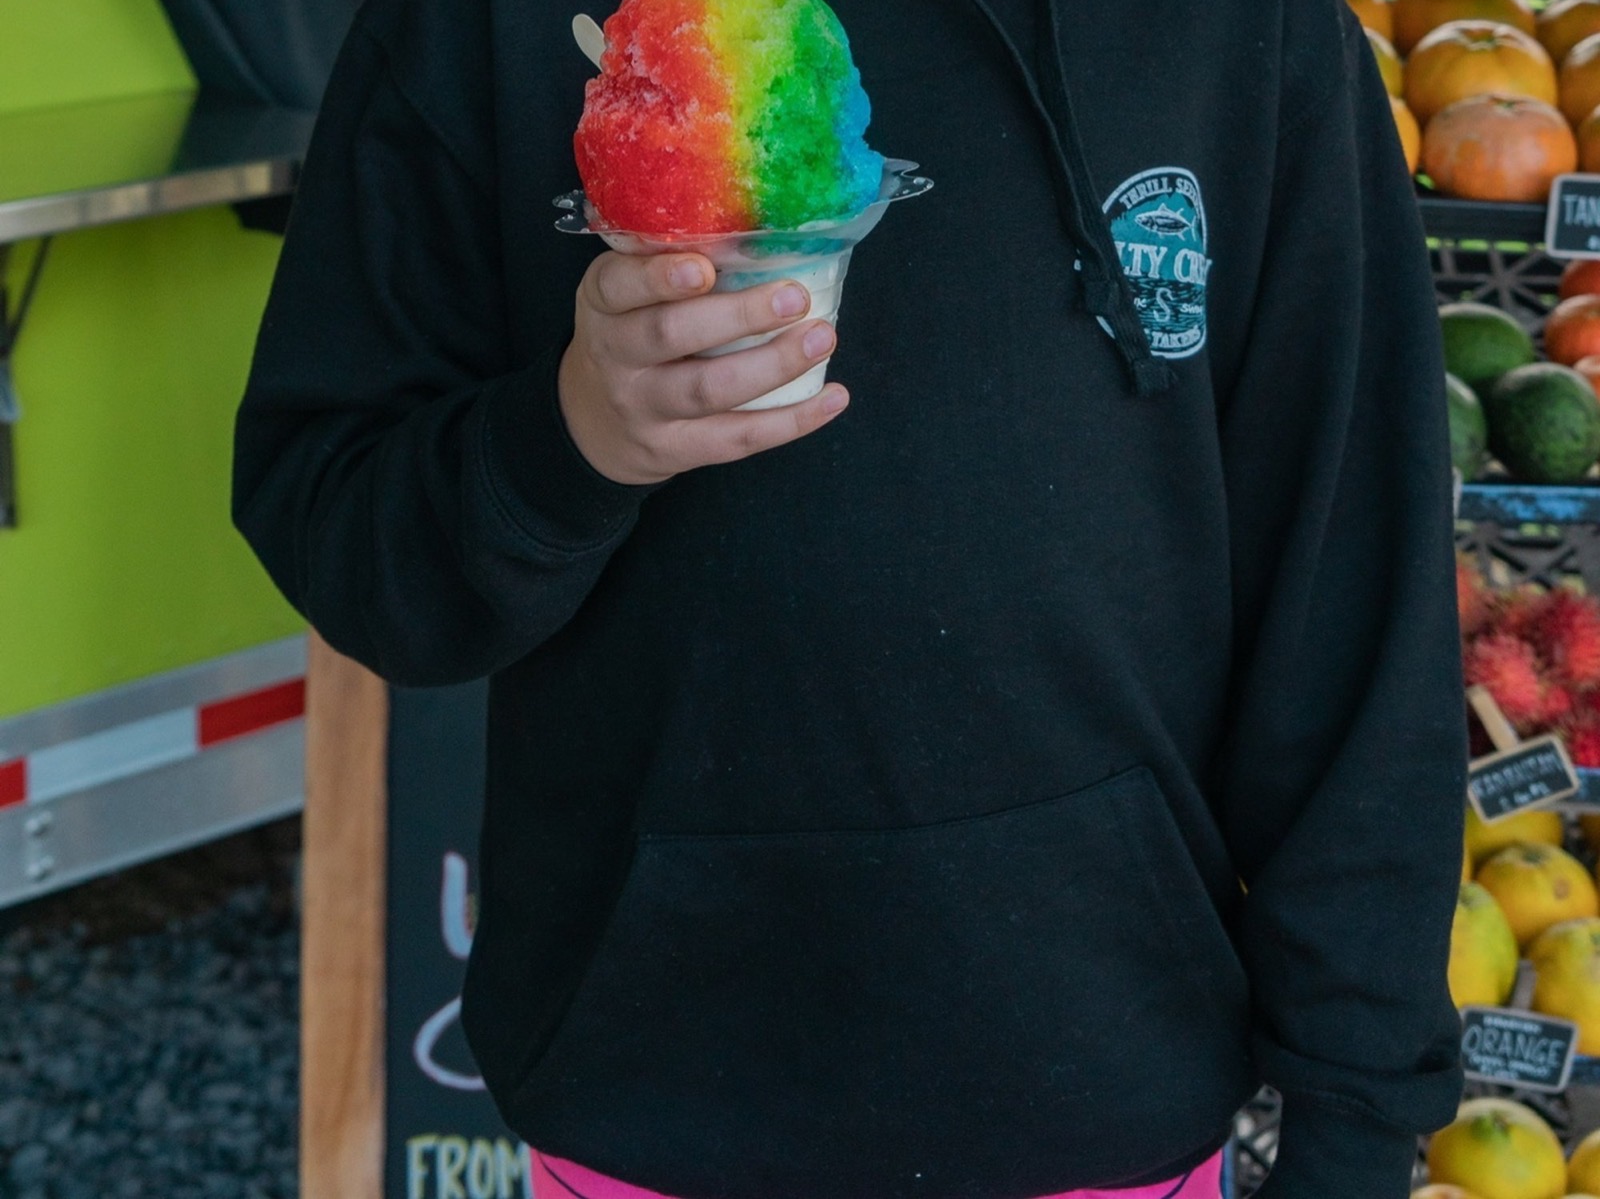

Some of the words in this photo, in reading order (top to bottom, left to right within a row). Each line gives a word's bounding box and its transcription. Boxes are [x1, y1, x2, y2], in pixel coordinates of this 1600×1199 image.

[1119, 176, 1173, 210] THRILL
[1461, 1023, 1567, 1069] ORANGE
[405, 1132, 532, 1199] FROM
